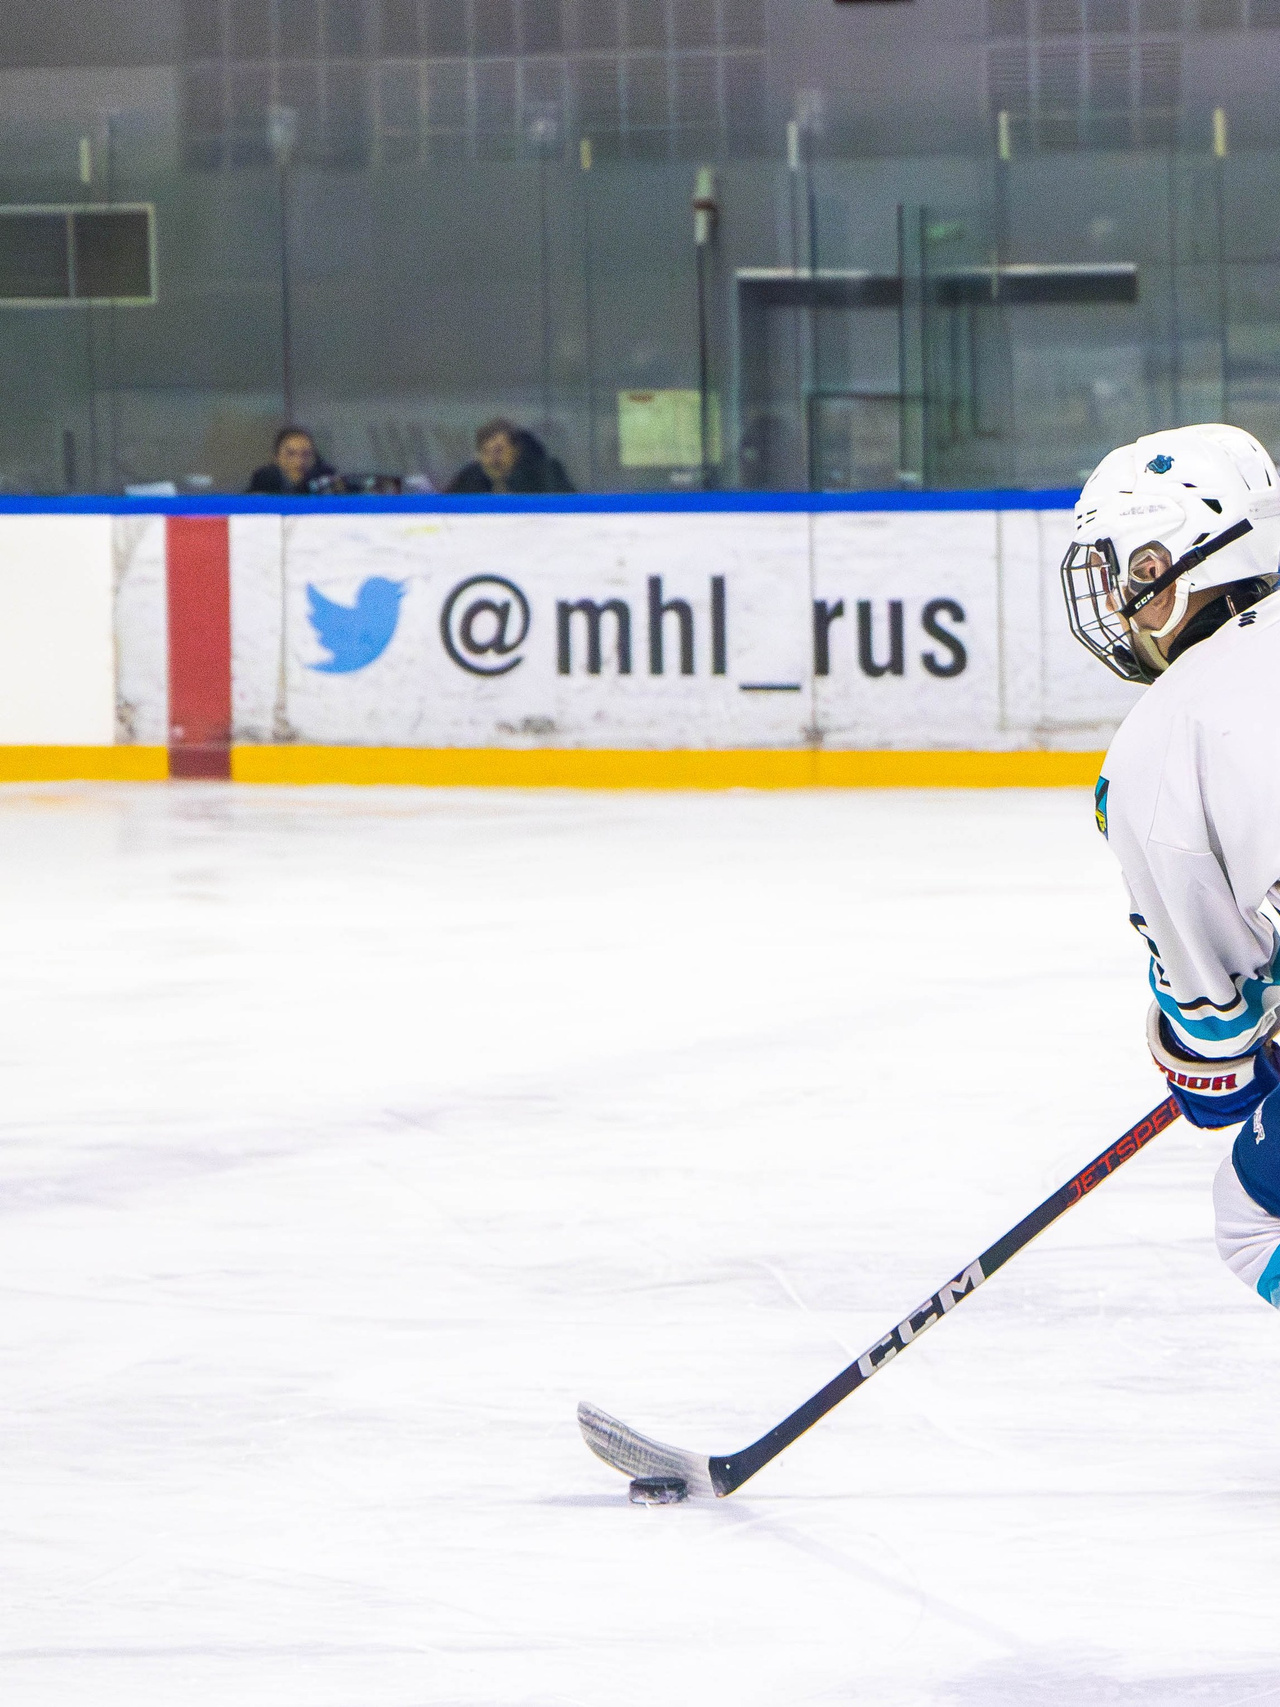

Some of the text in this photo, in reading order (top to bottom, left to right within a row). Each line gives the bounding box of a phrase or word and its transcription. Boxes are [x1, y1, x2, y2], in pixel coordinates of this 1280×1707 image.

[440, 573, 968, 691] @mhl_rus
[1135, 591, 1154, 610] CCM
[858, 1258, 986, 1378] CCM
